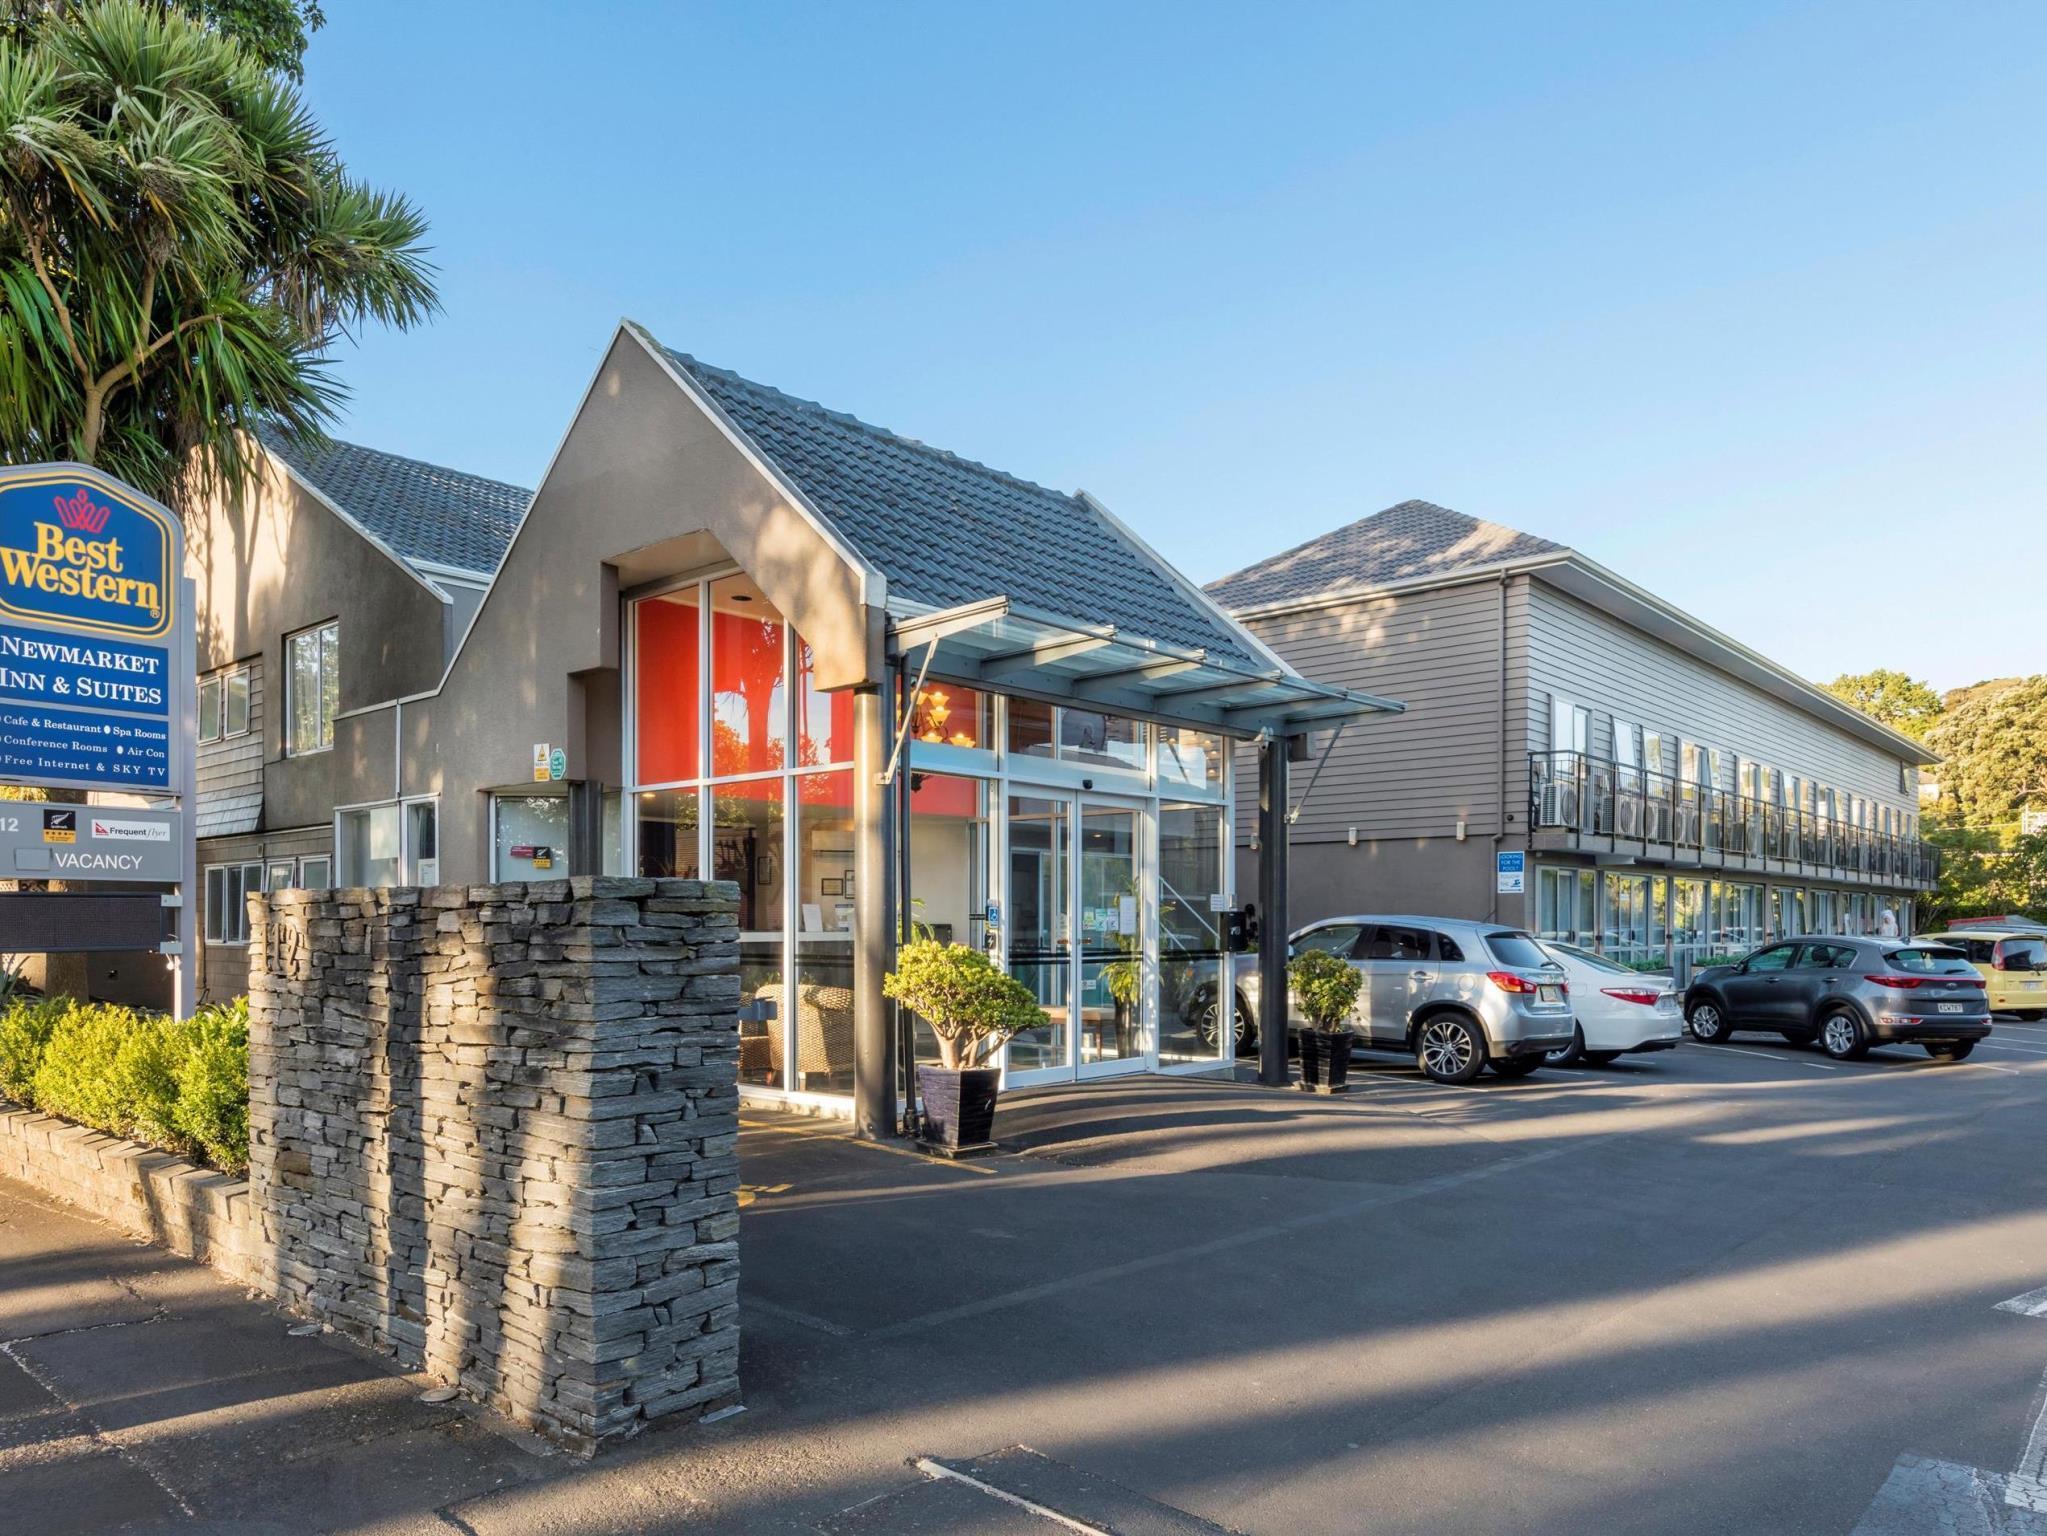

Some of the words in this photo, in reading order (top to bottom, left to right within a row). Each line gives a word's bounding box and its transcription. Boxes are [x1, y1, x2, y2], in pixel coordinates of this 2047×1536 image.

[34, 521, 124, 573] Best
[0, 546, 161, 610] Western
[0, 635, 160, 675] NEWMARKET
[0, 667, 46, 691] INN
[52, 676, 71, 694] &
[76, 676, 162, 704] SUITES
[3, 715, 29, 726] Cafe
[31, 718, 41, 728] &
[44, 719, 102, 733] Restaurant
[113, 727, 131, 738] Spa
[134, 729, 166, 740] Rooms
[3, 735, 68, 749] Conference
[72, 741, 108, 753] Rooms
[127, 747, 144, 757] Air
[146, 748, 165, 758] Con
[5, 755, 33, 766] Free
[38, 757, 91, 770] Internet
[96, 762, 105, 772] &
[113, 764, 141, 774] SKY
[148, 766, 166, 777] TV
[109, 826, 147, 836] Frequent
[55, 853, 143, 870] VACANCY
